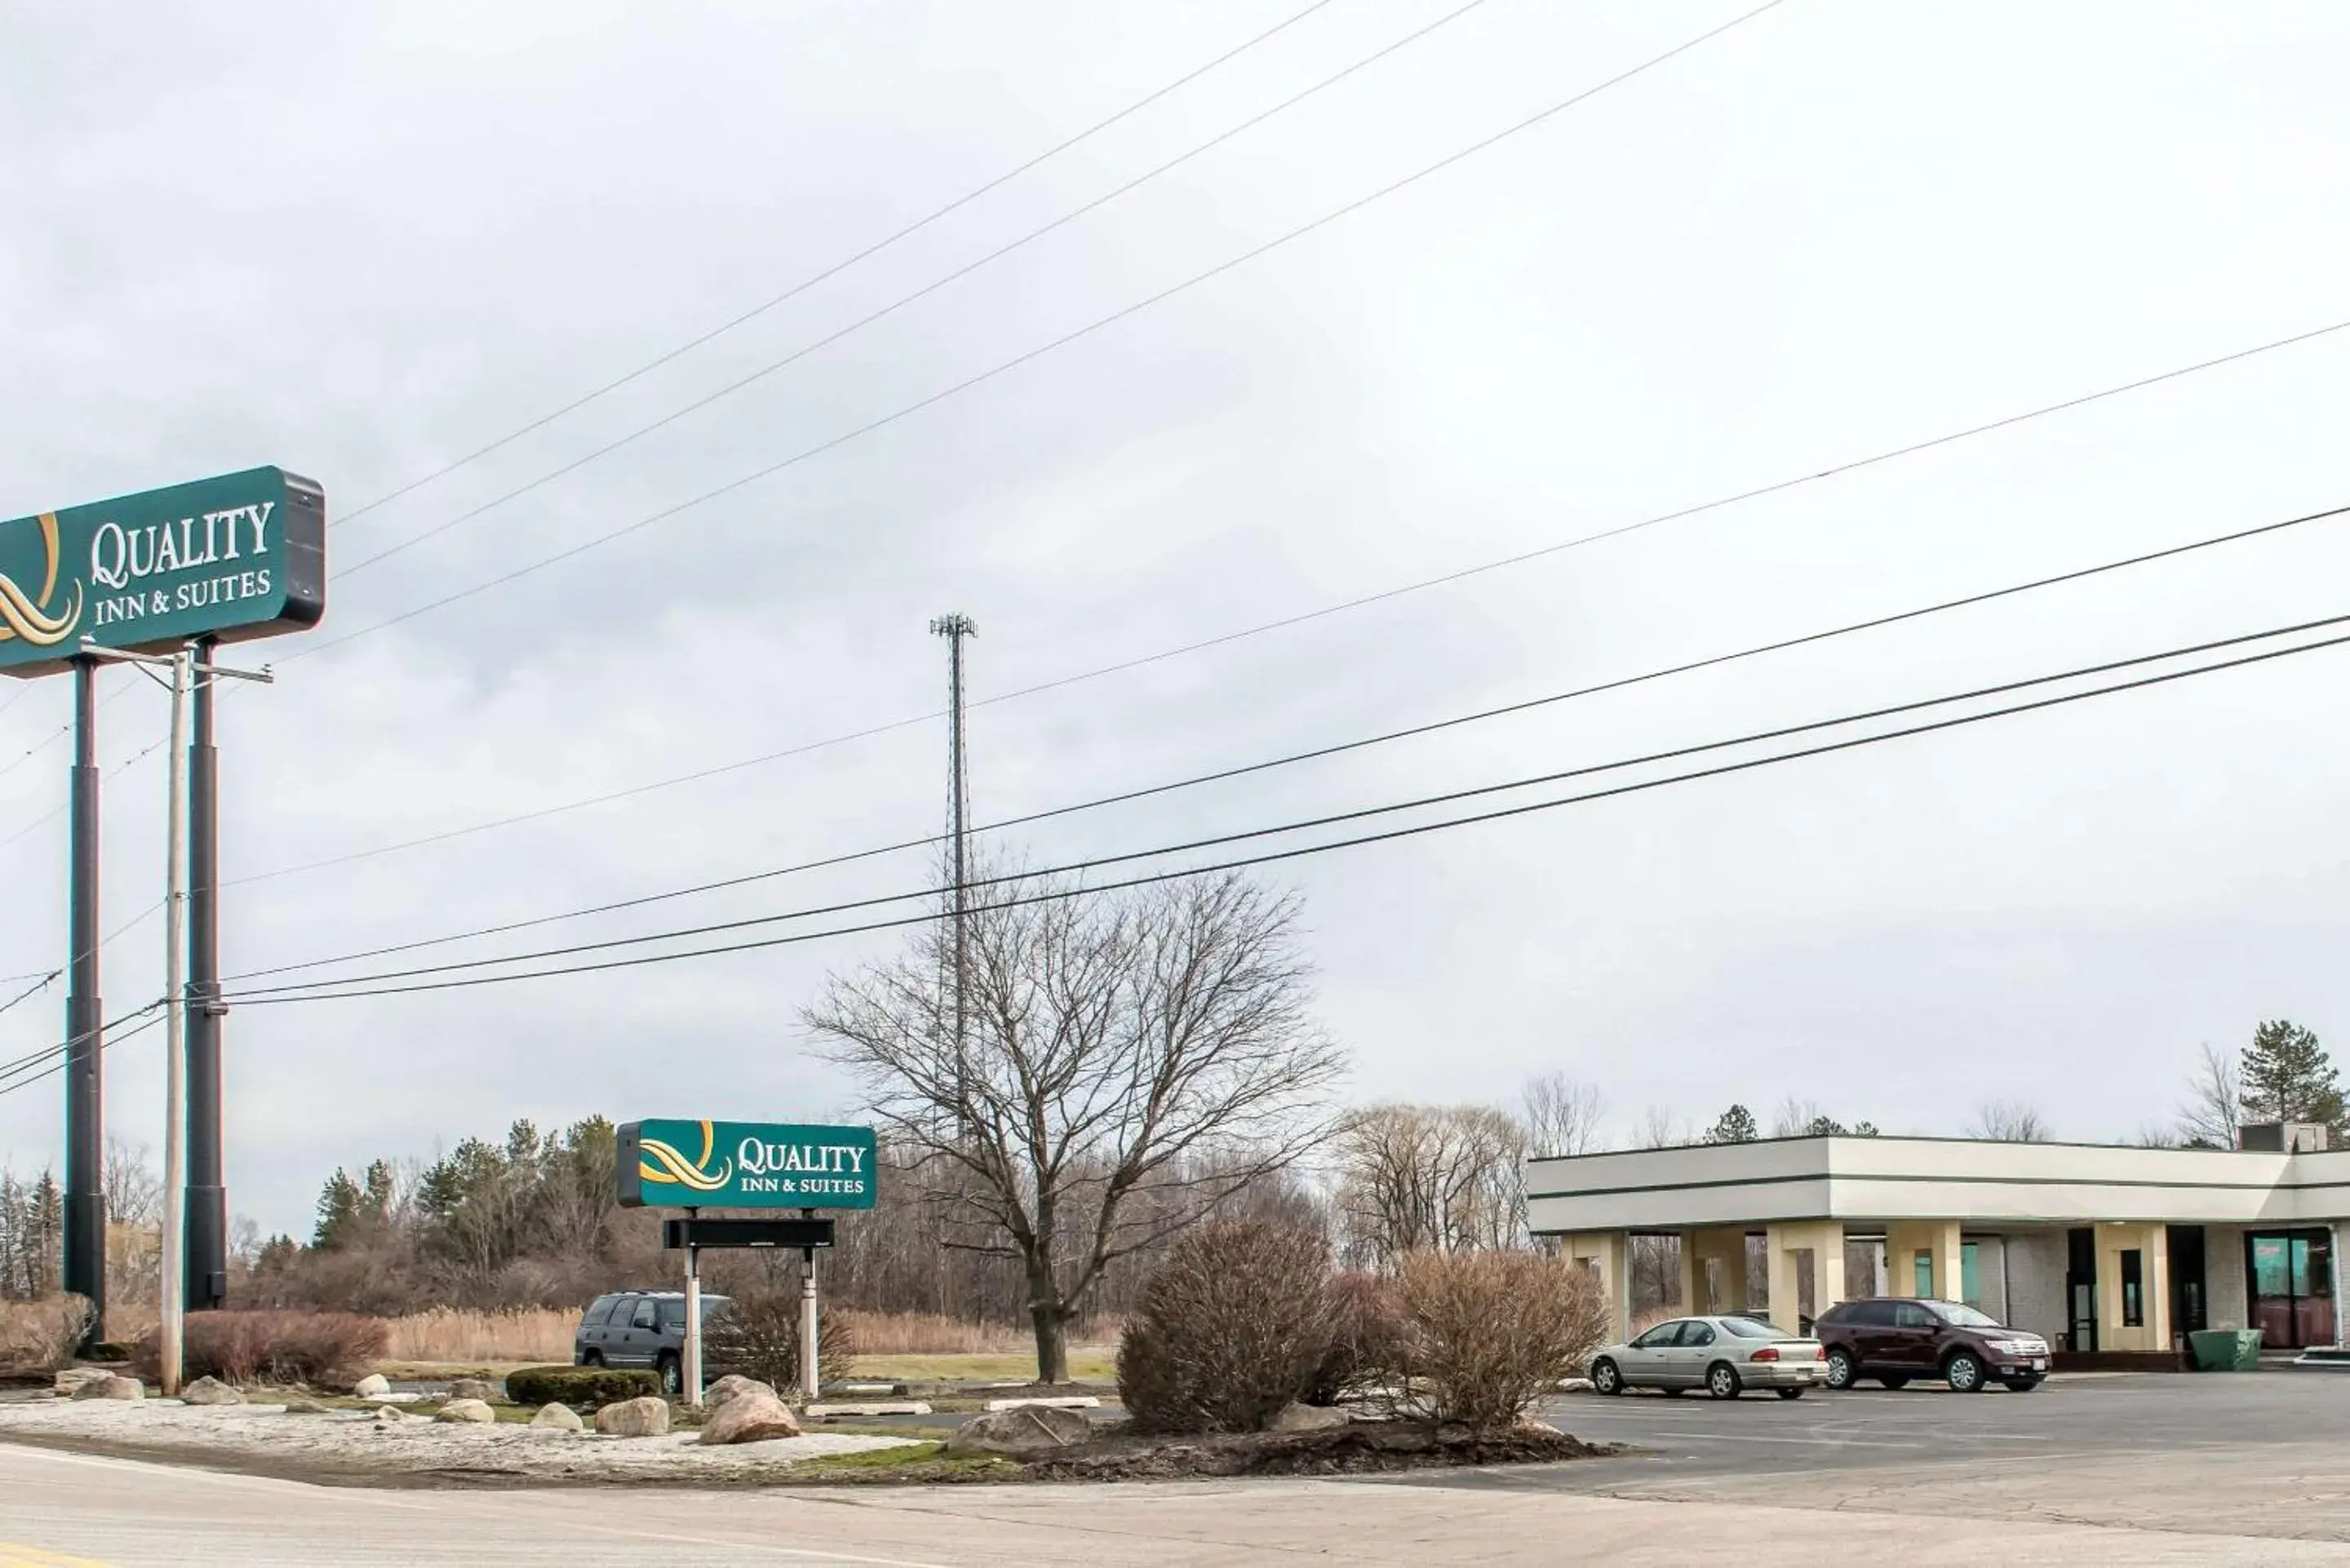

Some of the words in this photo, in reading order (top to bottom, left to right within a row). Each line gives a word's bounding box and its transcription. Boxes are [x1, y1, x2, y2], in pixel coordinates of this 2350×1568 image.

[92, 502, 275, 589] QUALITY
[95, 593, 145, 626] INN
[152, 590, 170, 614] &
[176, 569, 271, 609] SUITES
[738, 1137, 867, 1174] QUALITY
[741, 1178, 778, 1192] INN
[783, 1179, 796, 1192] &
[800, 1180, 864, 1194] SUITES
